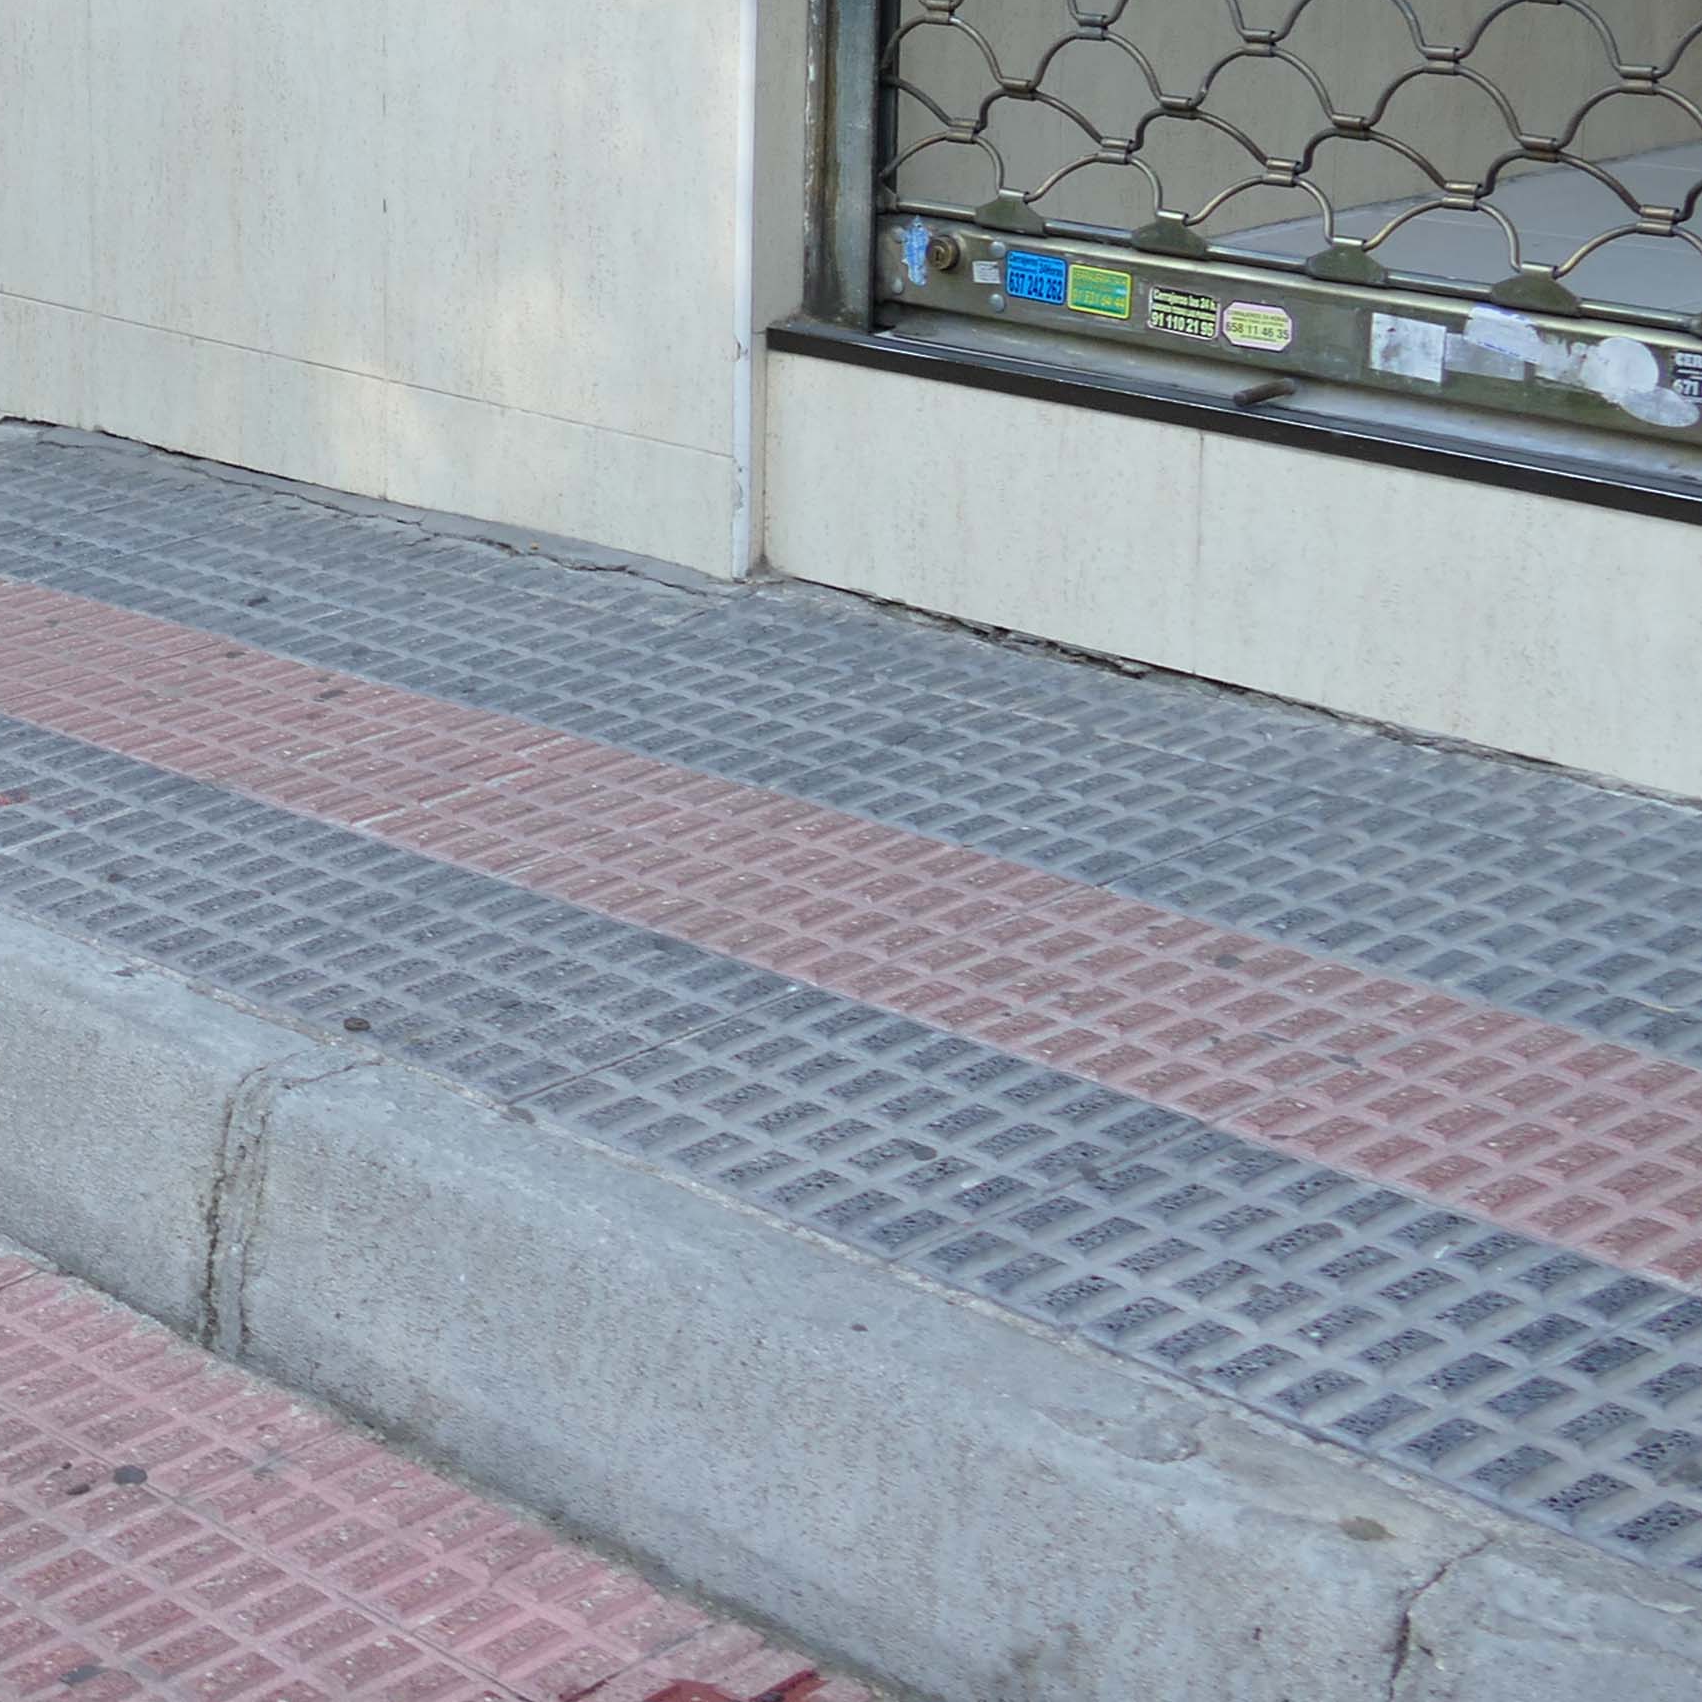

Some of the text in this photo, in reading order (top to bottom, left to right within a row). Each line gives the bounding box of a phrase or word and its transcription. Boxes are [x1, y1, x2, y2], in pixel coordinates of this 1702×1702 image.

[1028, 274, 1045, 298] 242
[1046, 277, 1063, 301] 262
[1151, 311, 1164, 327] 91
[1166, 314, 1185, 331] 110
[1186, 319, 1199, 334] 21
